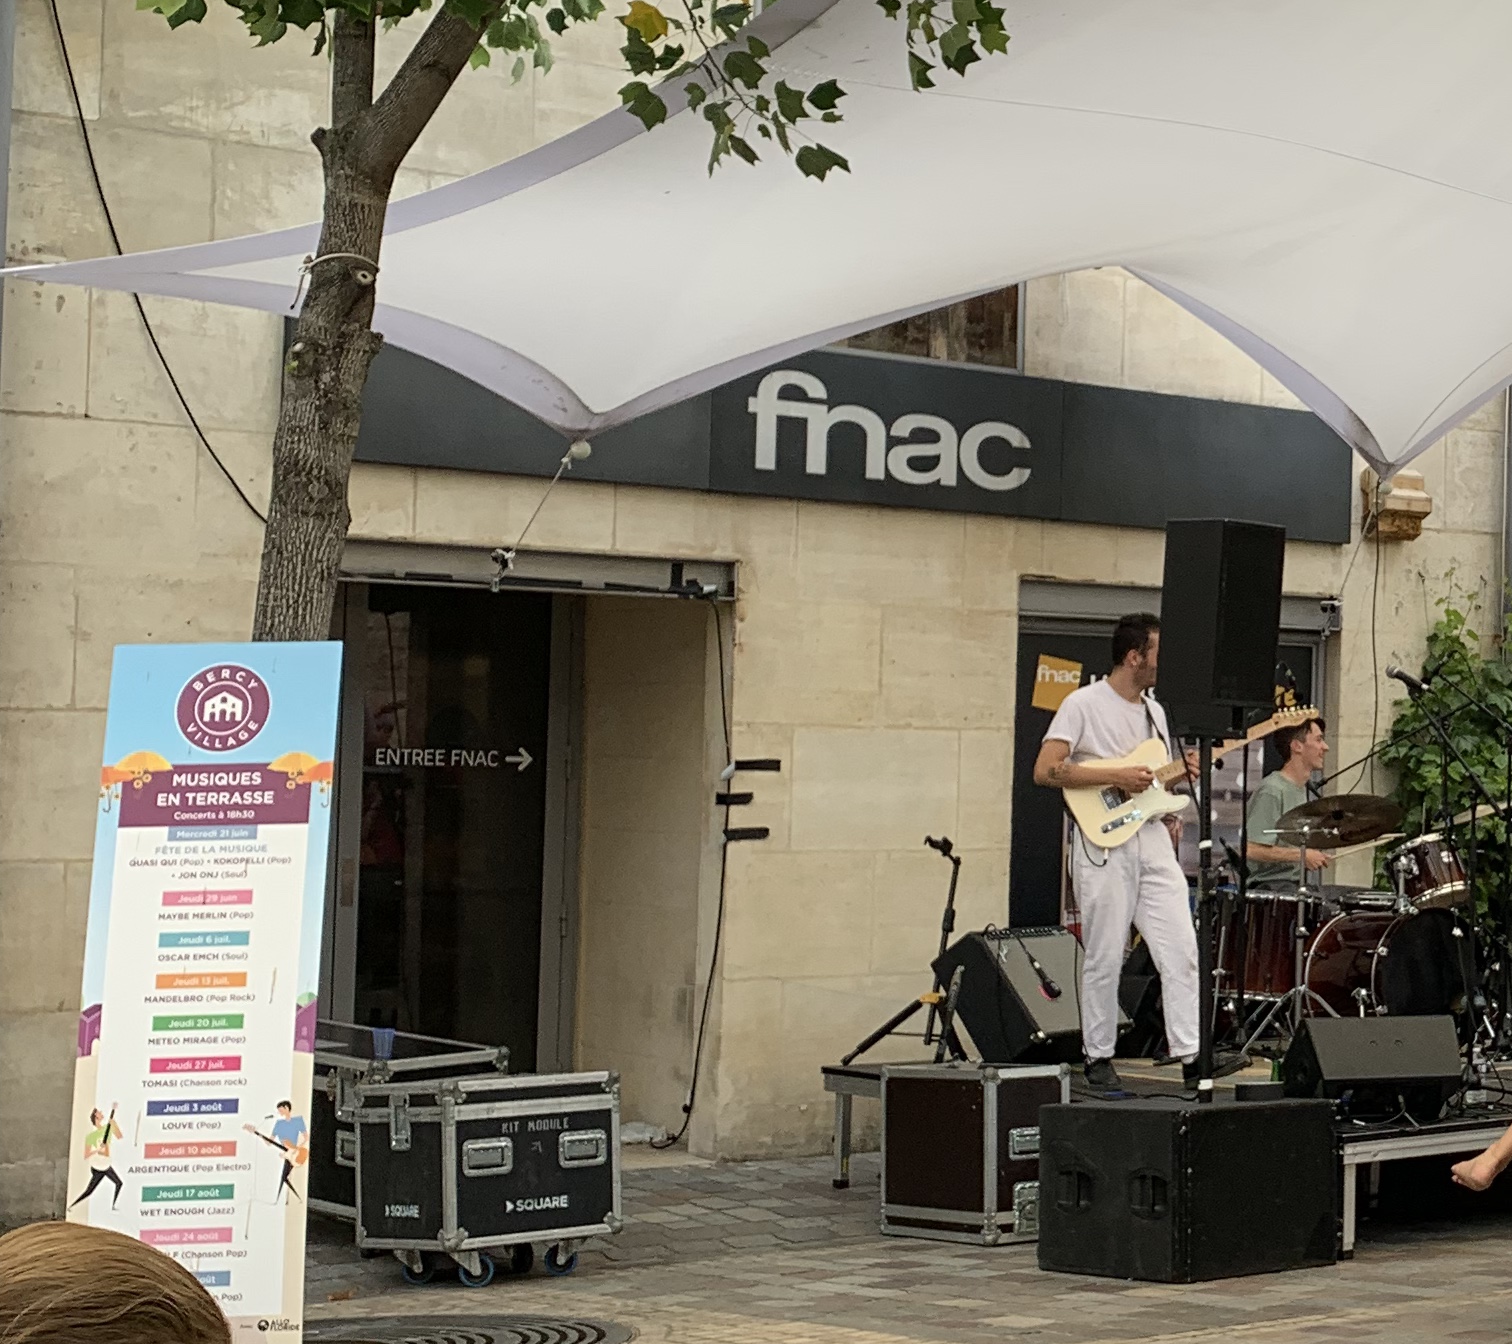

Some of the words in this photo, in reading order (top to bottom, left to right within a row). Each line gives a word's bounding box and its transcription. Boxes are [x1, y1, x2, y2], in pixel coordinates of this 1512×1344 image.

[748, 369, 1032, 491] fnac
[1037, 664, 1081, 683] fnac
[192, 668, 258, 692] BERCY
[187, 720, 258, 748] VILLAGE
[375, 748, 446, 766] ENTREE
[451, 749, 499, 767] FNAC
[172, 771, 262, 787] MUSIQUES
[156, 792, 180, 807] EN
[186, 791, 275, 806] TERRASSE
[174, 810, 216, 821] Concerts
[218, 809, 224, 820] à
[227, 809, 255, 820] 18h30
[177, 829, 217, 839] Mercredi
[220, 829, 230, 838] 21
[231, 829, 248, 839] juin
[155, 844, 182, 855] FÊTE
[185, 845, 199, 854] DE
[202, 845, 216, 854] LA
[219, 844, 267, 854] MUSIQUE
[129, 858, 158, 867] QUASI
[179, 857, 204, 867] (Pop)
[214, 857, 265, 865] KOKOPELLI
[266, 856, 292, 865] (Pop)
[177, 895, 203, 904] Jeudi
[205, 894, 218, 902] 29
[219, 894, 238, 904] juin
[158, 913, 189, 921] MAYBE
[192, 912, 227, 920] MERLIN
[229, 911, 254, 920] (Pop)
[178, 936, 204, 945] Jeudi
[157, 954, 190, 962] OSCAR
[221, 953, 249, 962] (Soul)
[173, 977, 199, 986] Jeudi
[206, 994, 226, 1003] (Pop
[229, 993, 256, 1002] Rock)
[168, 1019, 195, 1029] Jeudi
[197, 1019, 210, 1027] 20
[148, 1038, 180, 1046] METEO
[183, 1037, 219, 1045] MIRAGE
[221, 1035, 246, 1045] (Pop)
[166, 1060, 192, 1070] Jeudi
[194, 1060, 206, 1069] 27
[141, 1080, 178, 1088] TOMASI
[180, 1079, 222, 1088] (Chanson
[224, 1078, 248, 1087] rock)
[163, 1103, 190, 1113] Jeudi
[192, 1103, 199, 1112] 3
[200, 1101, 222, 1112] août
[162, 1122, 194, 1130] LOUVE
[196, 1121, 221, 1131] (Pop)
[158, 1146, 185, 1156] Jeudi
[187, 1146, 199, 1155] 10
[200, 1144, 222, 1155] août
[128, 1165, 190, 1174] ARGENTIQUE
[192, 1164, 214, 1173] (Pop
[216, 1163, 252, 1172] Electro)
[156, 1189, 183, 1199] Jeudi
[185, 1189, 196, 1198] 17
[197, 1187, 220, 1198] août
[515, 1195, 569, 1212] SQUARE
[140, 1208, 161, 1217] WET
[164, 1208, 205, 1216] ENOUGH
[206, 1207, 235, 1216] (Jazz)
[153, 1233, 180, 1243] Jeudi
[182, 1232, 194, 1242] 24
[197, 1231, 219, 1242] août
[181, 1250, 223, 1260] (Chanson
[226, 1249, 247, 1259] Pop)
[221, 1293, 242, 1302] Pop)
